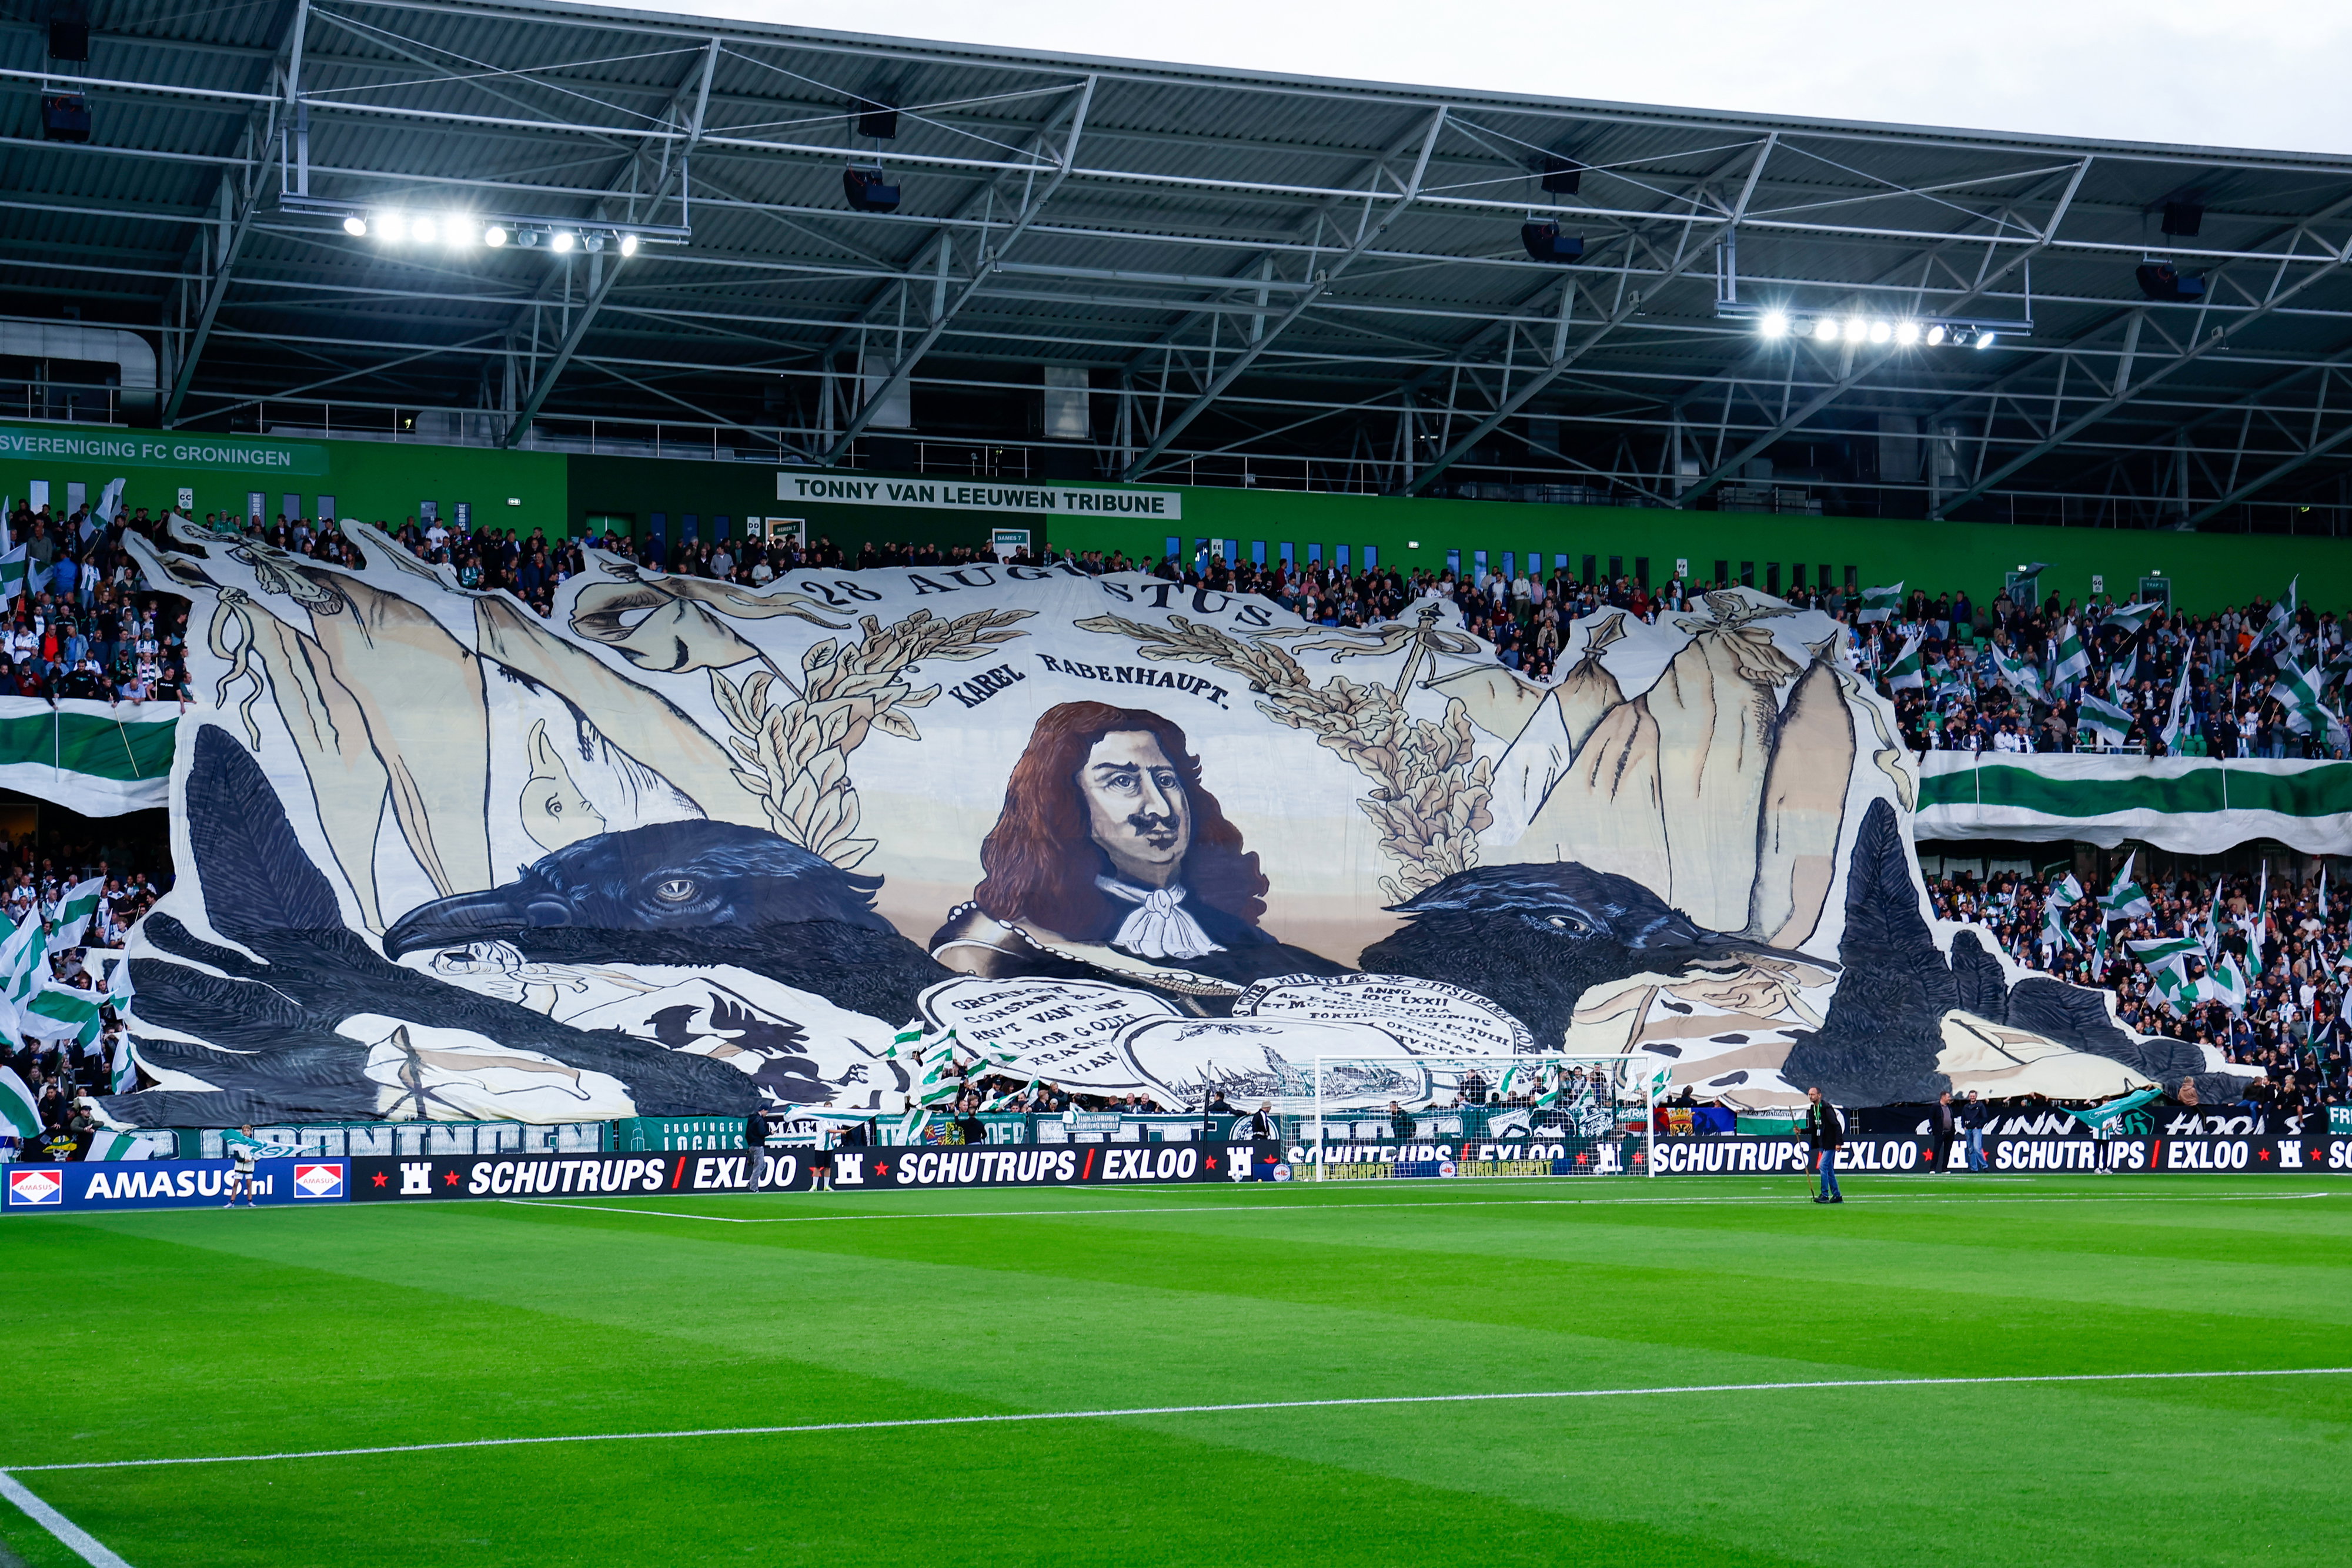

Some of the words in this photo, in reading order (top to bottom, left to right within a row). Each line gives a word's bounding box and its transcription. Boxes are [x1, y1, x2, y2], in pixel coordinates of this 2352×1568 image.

[142, 444, 167, 459] FC
[173, 445, 291, 466] GRONINGEN
[794, 478, 880, 499] TONNY
[887, 483, 935, 502] VAN
[943, 486, 1056, 509] LEEUWEN
[1063, 492, 1165, 513] TRIBUNE
[800, 580, 882, 606] 28
[948, 663, 1027, 708] KAREL
[1035, 653, 1229, 710] RABENHAUPT.
[1363, 987, 1411, 995] ANNO
[663, 1121, 744, 1134] GRONINGEN
[2330, 1106, 2352, 1125] FR
[897, 1150, 1076, 1184] SCHUTRUPS
[1101, 1147, 1197, 1180] EXLOO
[1457, 1159, 1553, 1176] EUROJACKPOT
[1653, 1142, 1810, 1172] SCHUTRUPS
[1833, 1141, 1917, 1171] EXLOO
[2167, 1140, 2249, 1169] EXLOO
[468, 1158, 666, 1195] SCHUTRUPS
